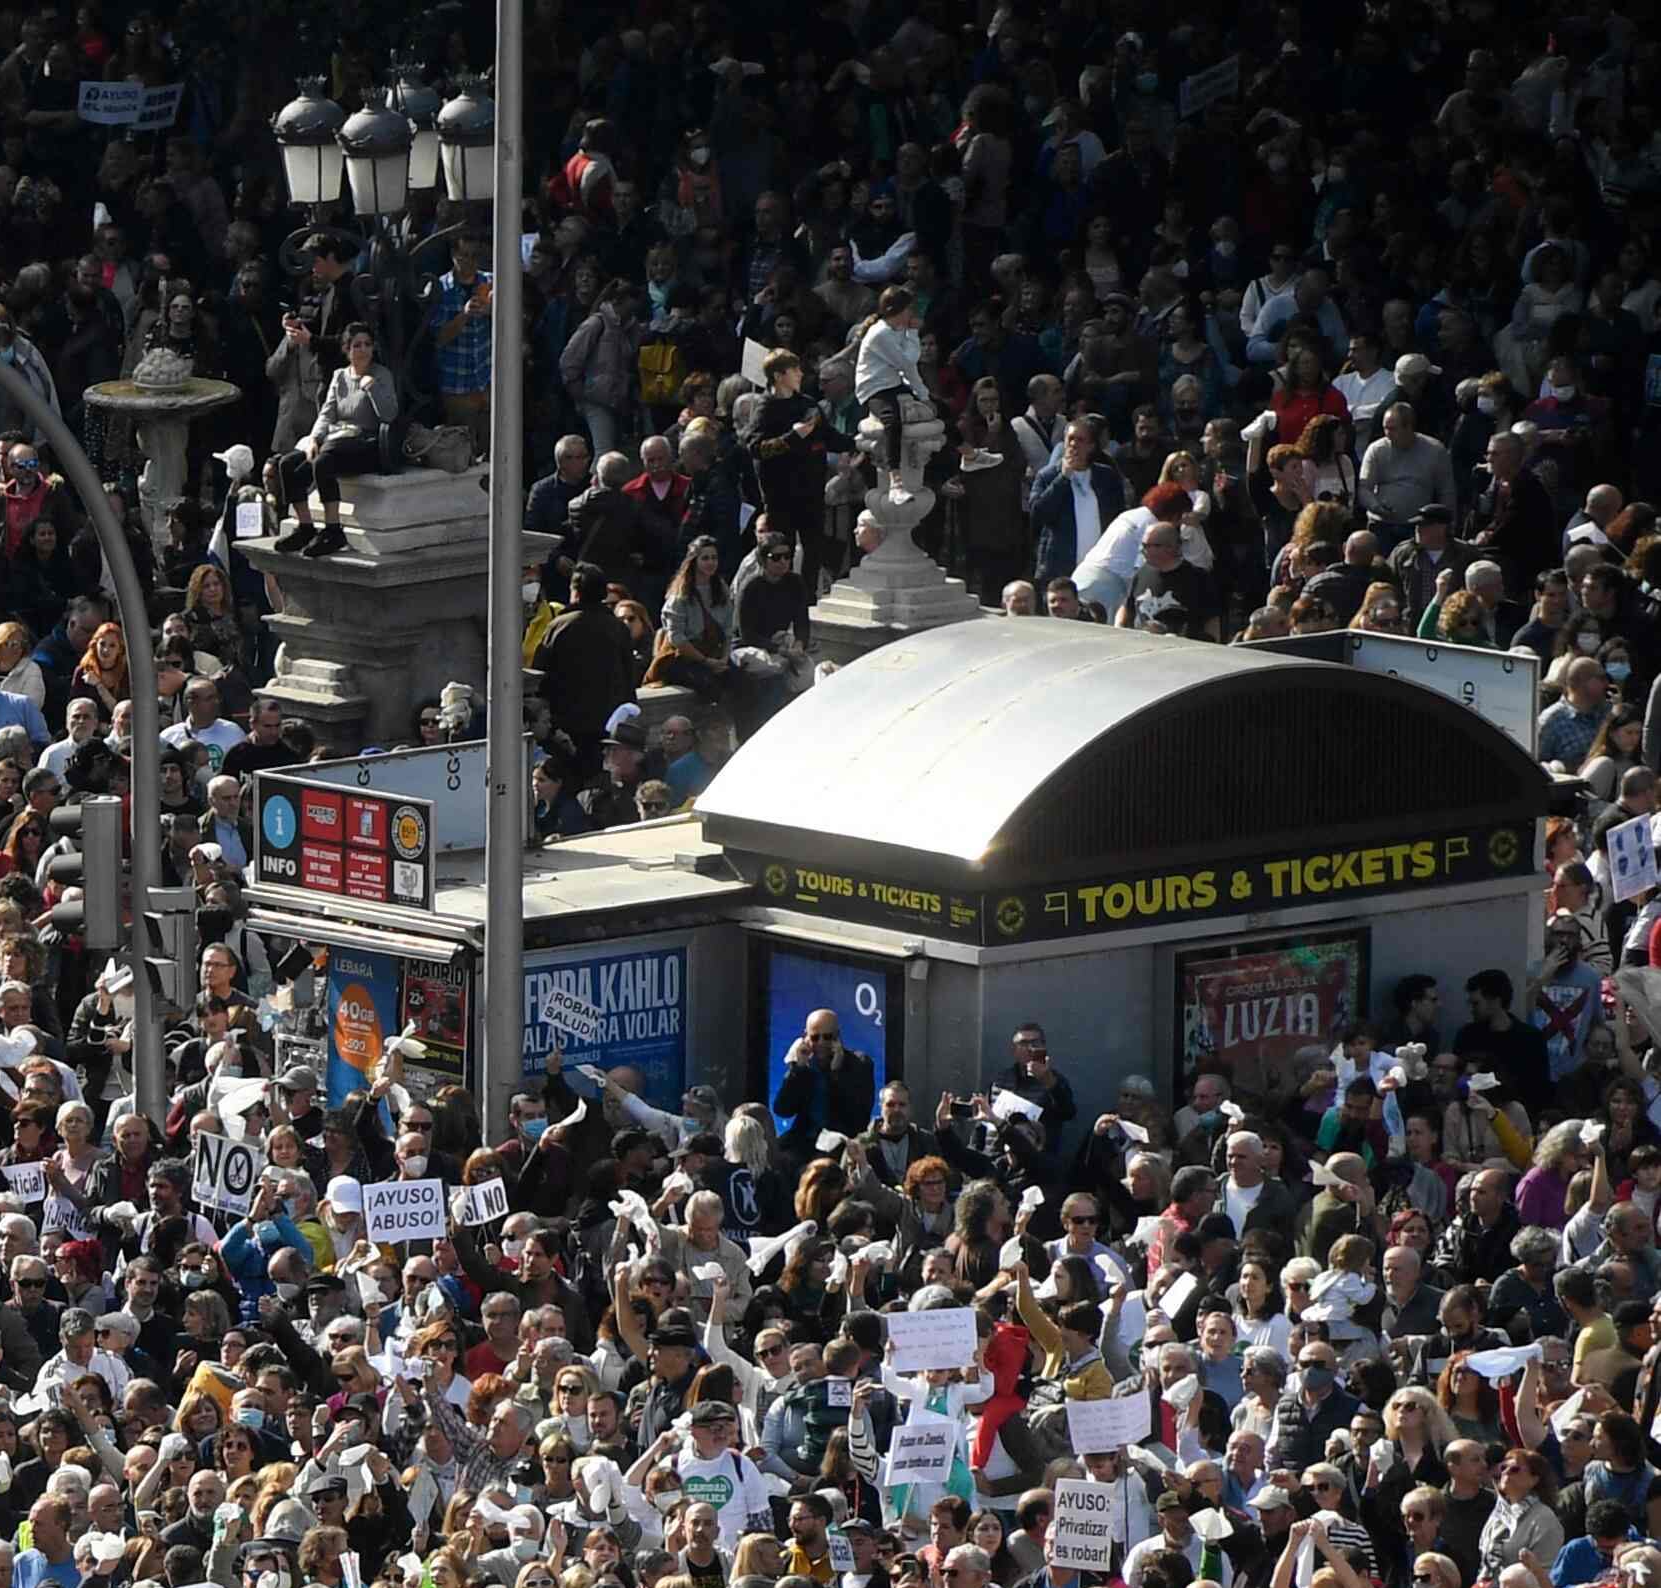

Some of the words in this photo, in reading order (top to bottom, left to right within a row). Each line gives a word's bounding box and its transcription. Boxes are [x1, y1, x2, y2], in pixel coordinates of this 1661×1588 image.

[263, 855, 296, 876] INFO
[796, 869, 852, 897] TOURS
[858, 883, 867, 897] &
[872, 883, 941, 913] TICKETS
[1078, 872, 1217, 923] TOURS
[1230, 871, 1251, 900] &
[1264, 841, 1436, 898] TICKETS
[334, 957, 374, 979] LEBARA
[599, 955, 680, 1012] KAHLO
[550, 991, 603, 1022] ¡ROBAN
[1224, 992, 1320, 1049] LUZIA
[629, 1008, 680, 1038] VOLAR
[197, 1135, 253, 1196] NO
[368, 1187, 438, 1212] ¡AYUSO,
[482, 1186, 504, 1214] NO
[372, 1210, 439, 1231] ABUSO!
[1057, 1491, 1110, 1512] AYUSO:
[1056, 1518, 1108, 1537] ¡Privatizar
[1056, 1545, 1068, 1558] es
[1071, 1542, 1108, 1563] robar!
